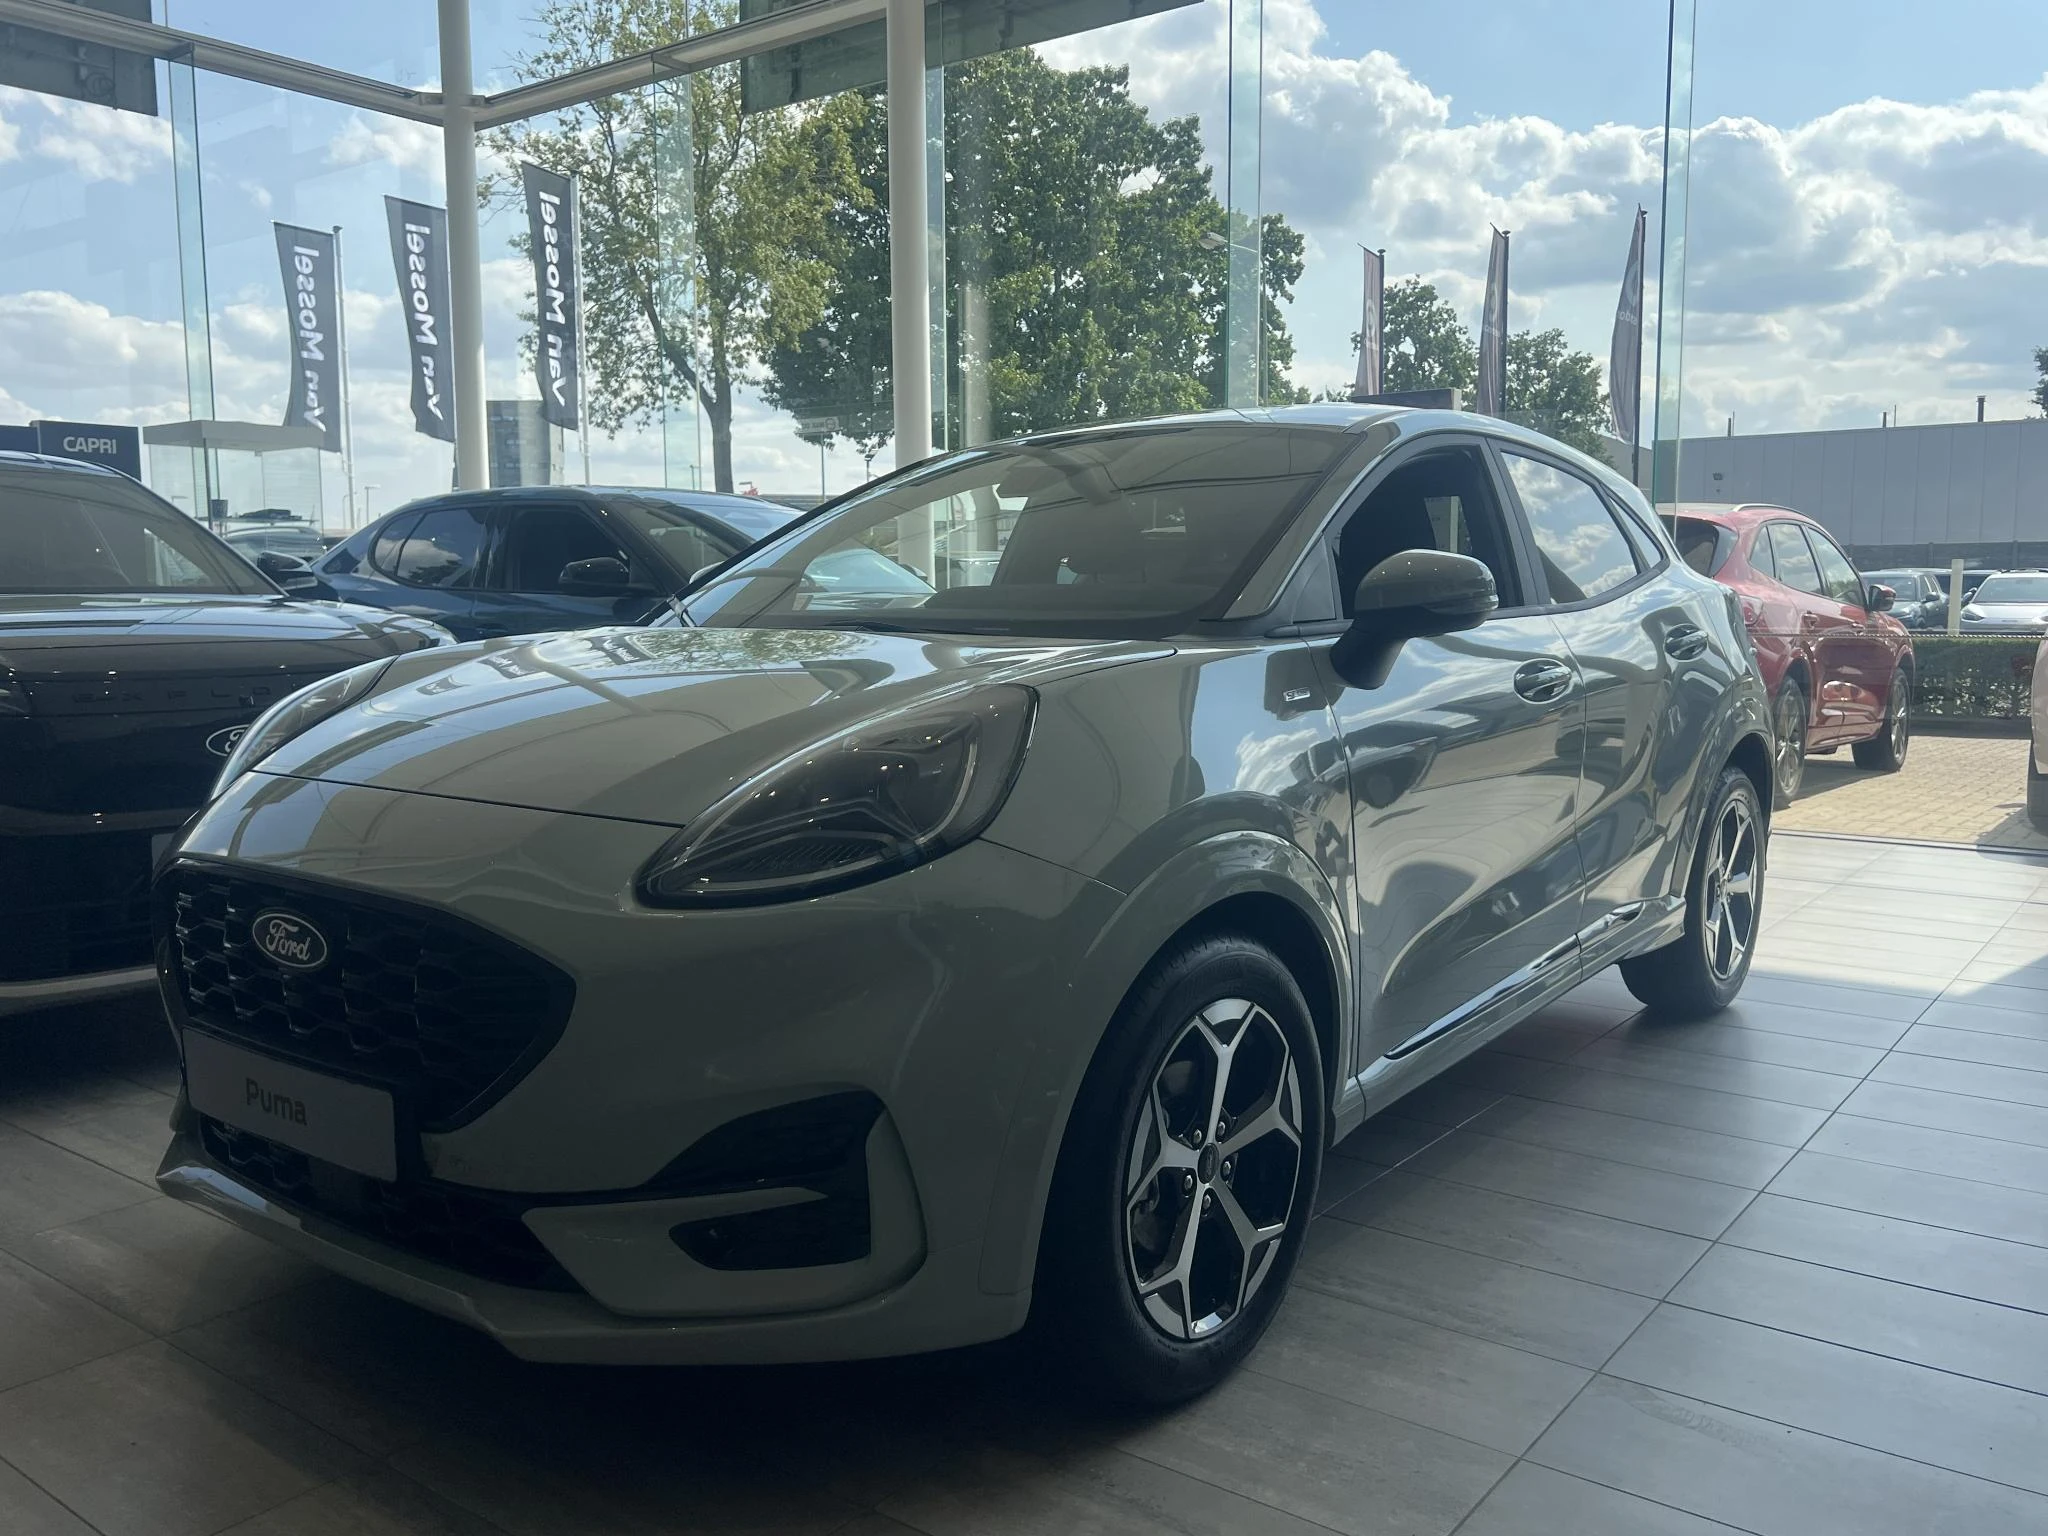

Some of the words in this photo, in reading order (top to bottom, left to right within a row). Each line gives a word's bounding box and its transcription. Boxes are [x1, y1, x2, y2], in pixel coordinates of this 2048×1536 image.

[63, 436, 117, 454] CAPRI
[265, 919, 312, 961] Ford
[245, 1077, 308, 1126] Puma
